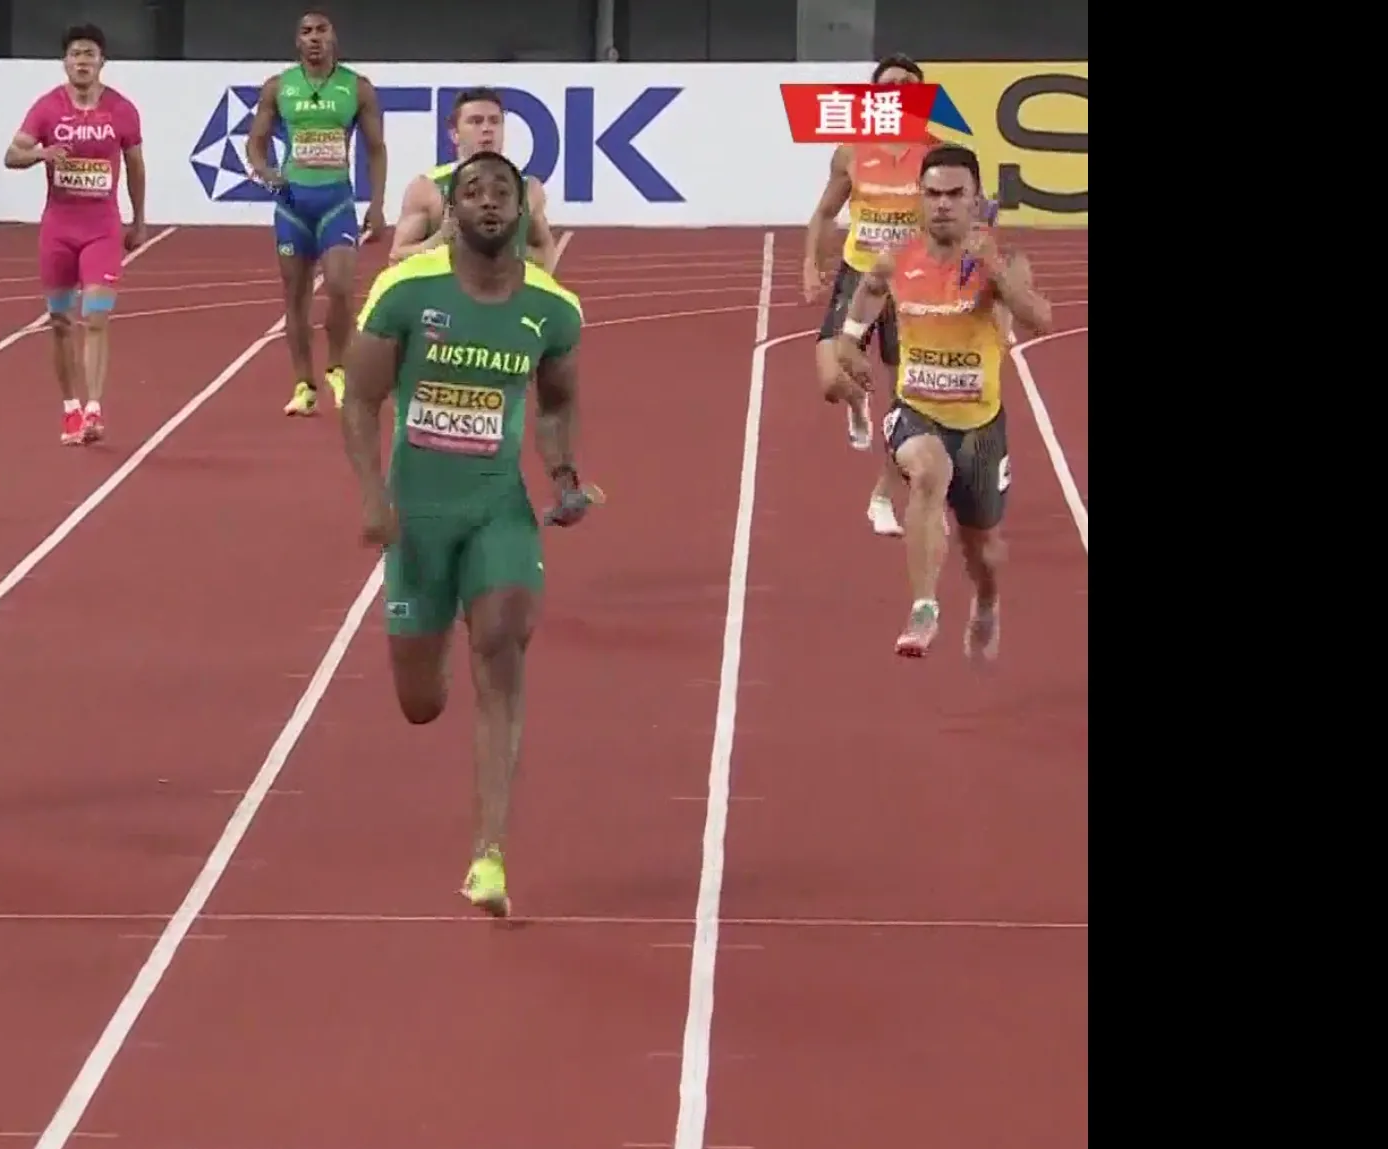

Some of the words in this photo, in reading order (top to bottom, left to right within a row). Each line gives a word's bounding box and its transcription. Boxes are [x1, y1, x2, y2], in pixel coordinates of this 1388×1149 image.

[294, 100, 336, 112] BRASIL
[54, 123, 116, 141] CHINA
[355, 86, 687, 202] TDK
[59, 174, 108, 189] WANG
[426, 343, 530, 375] AUSTRALIA
[908, 346, 983, 369] SEIKO
[414, 384, 503, 411] SEIKO
[413, 408, 499, 435] JACKSON
